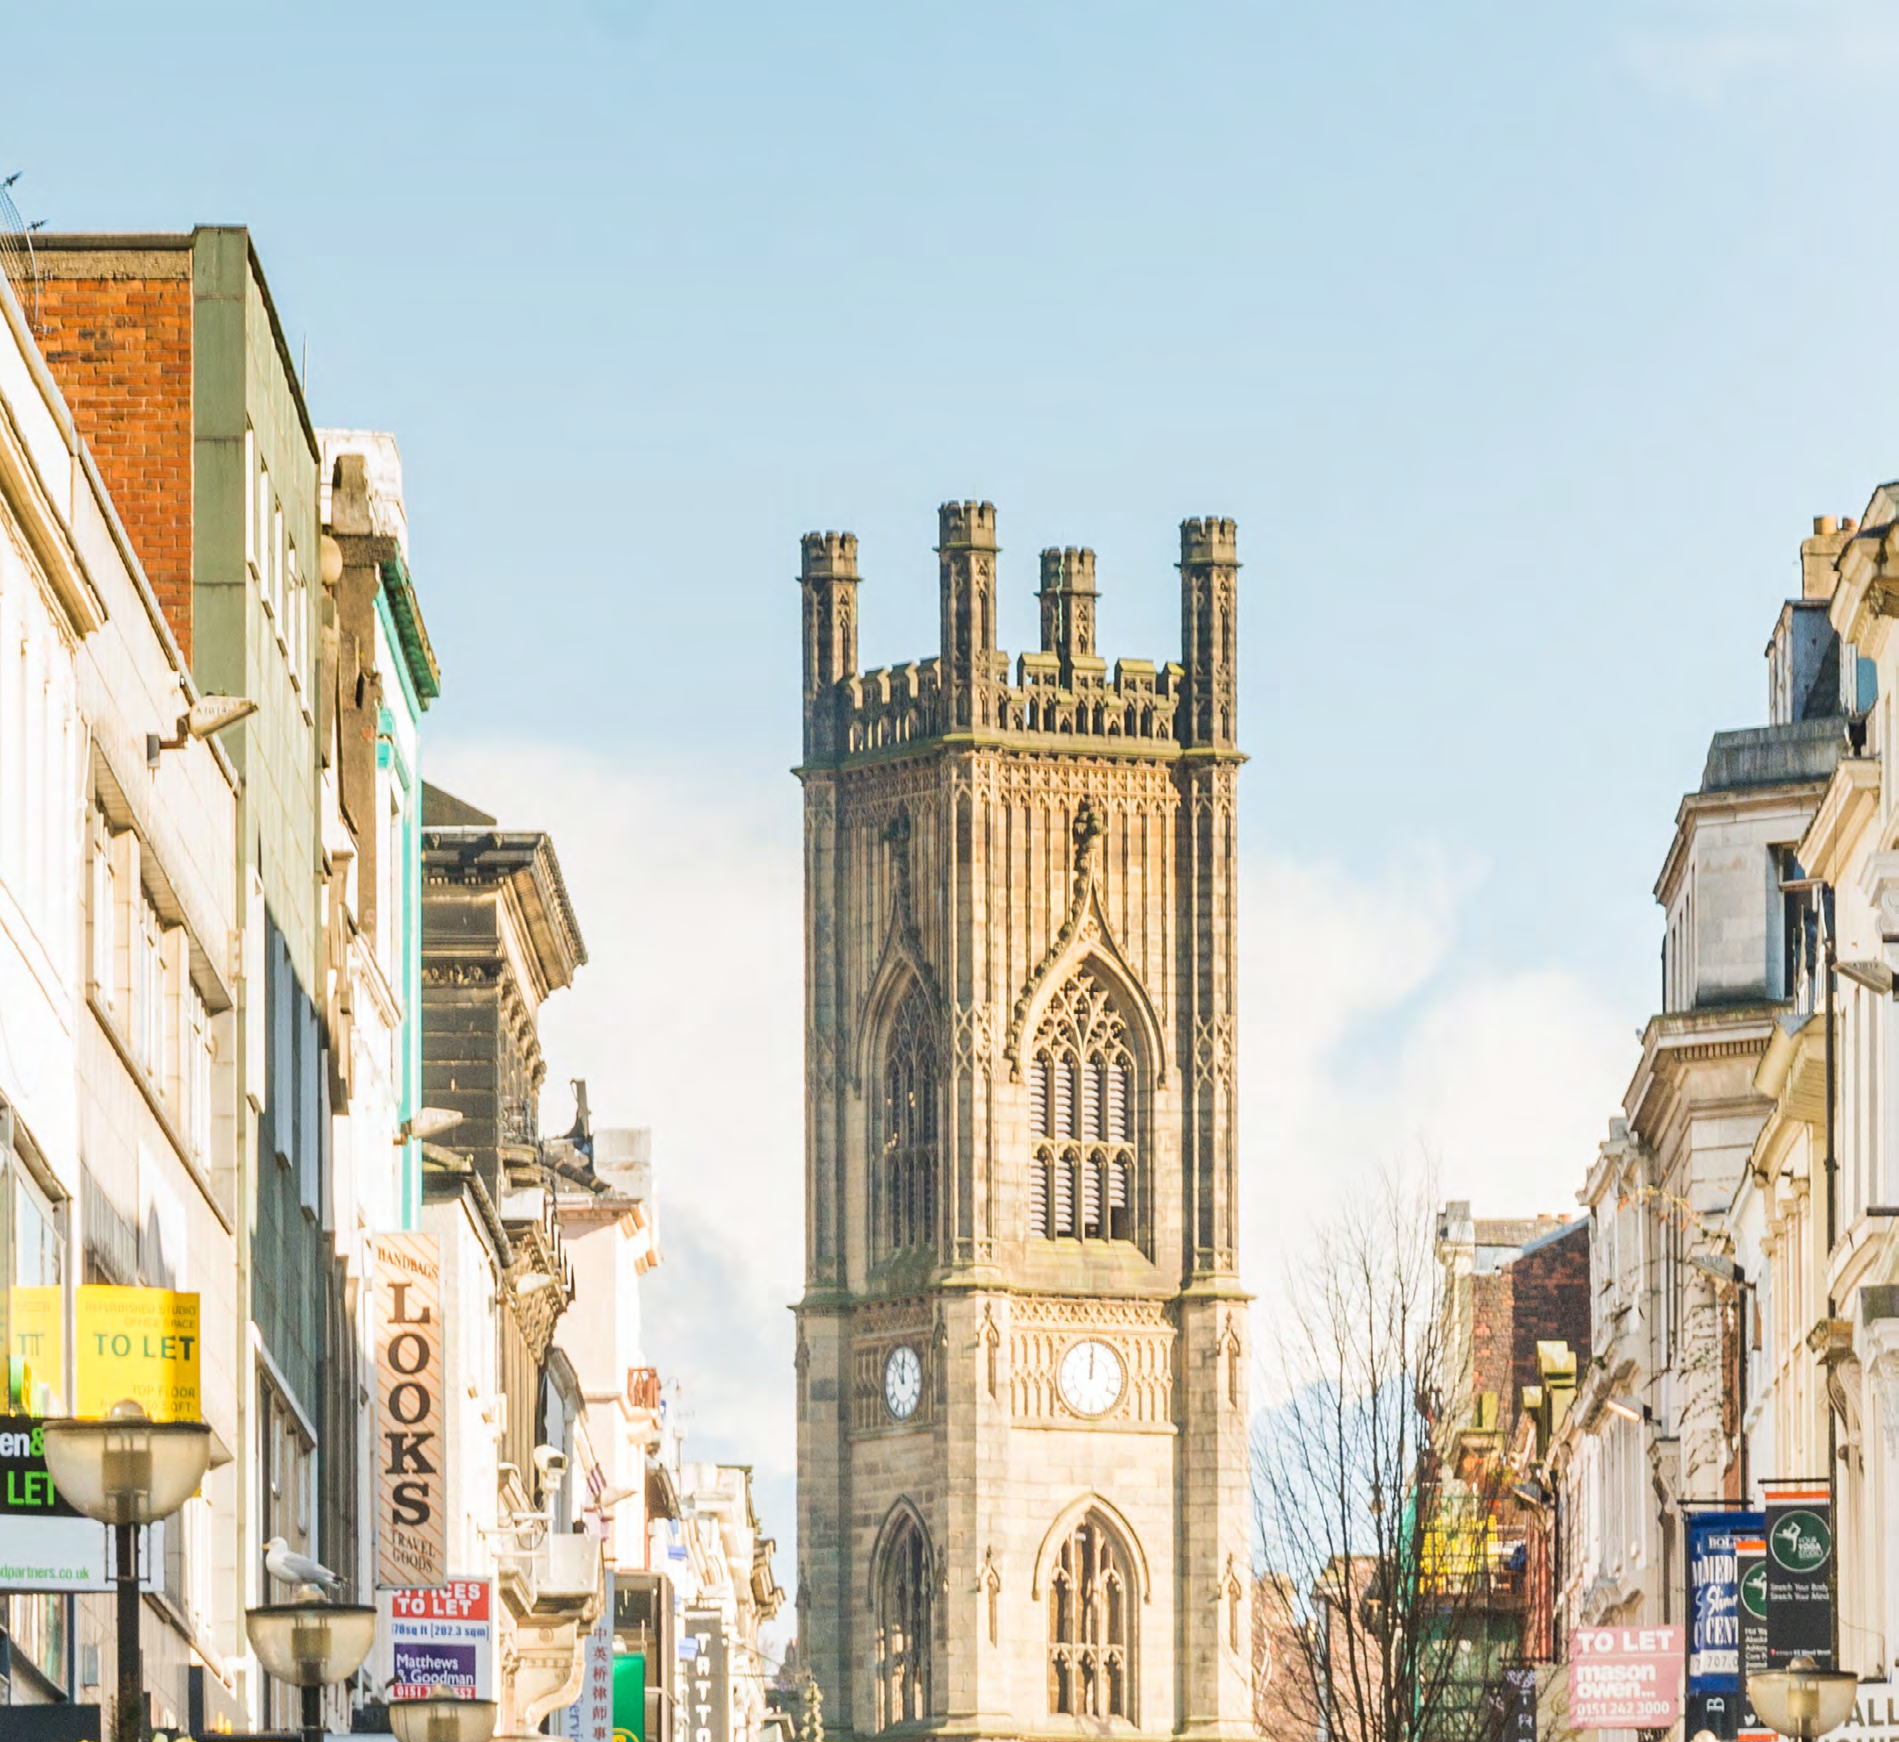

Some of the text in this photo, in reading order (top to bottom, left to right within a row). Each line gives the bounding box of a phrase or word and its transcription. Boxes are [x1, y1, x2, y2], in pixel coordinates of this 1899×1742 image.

[377, 1246, 439, 1279] HANDBAGS
[95, 1333, 195, 1361] TO LET
[384, 1282, 438, 1526] LOOKS
[7, 1470, 54, 1506] LET
[392, 1530, 436, 1558] TRAVEL
[393, 1547, 433, 1573] GOODS
[398, 1598, 472, 1616] TO LET
[1576, 1629, 1674, 1653] TO LET
[396, 1653, 459, 1671] Matthews
[1576, 1664, 1656, 1682] mason
[411, 1669, 474, 1686] Goodman
[396, 1684, 422, 1699] 0151
[1577, 1703, 1607, 1716] 0151
[1637, 1701, 1670, 1714] 3000
